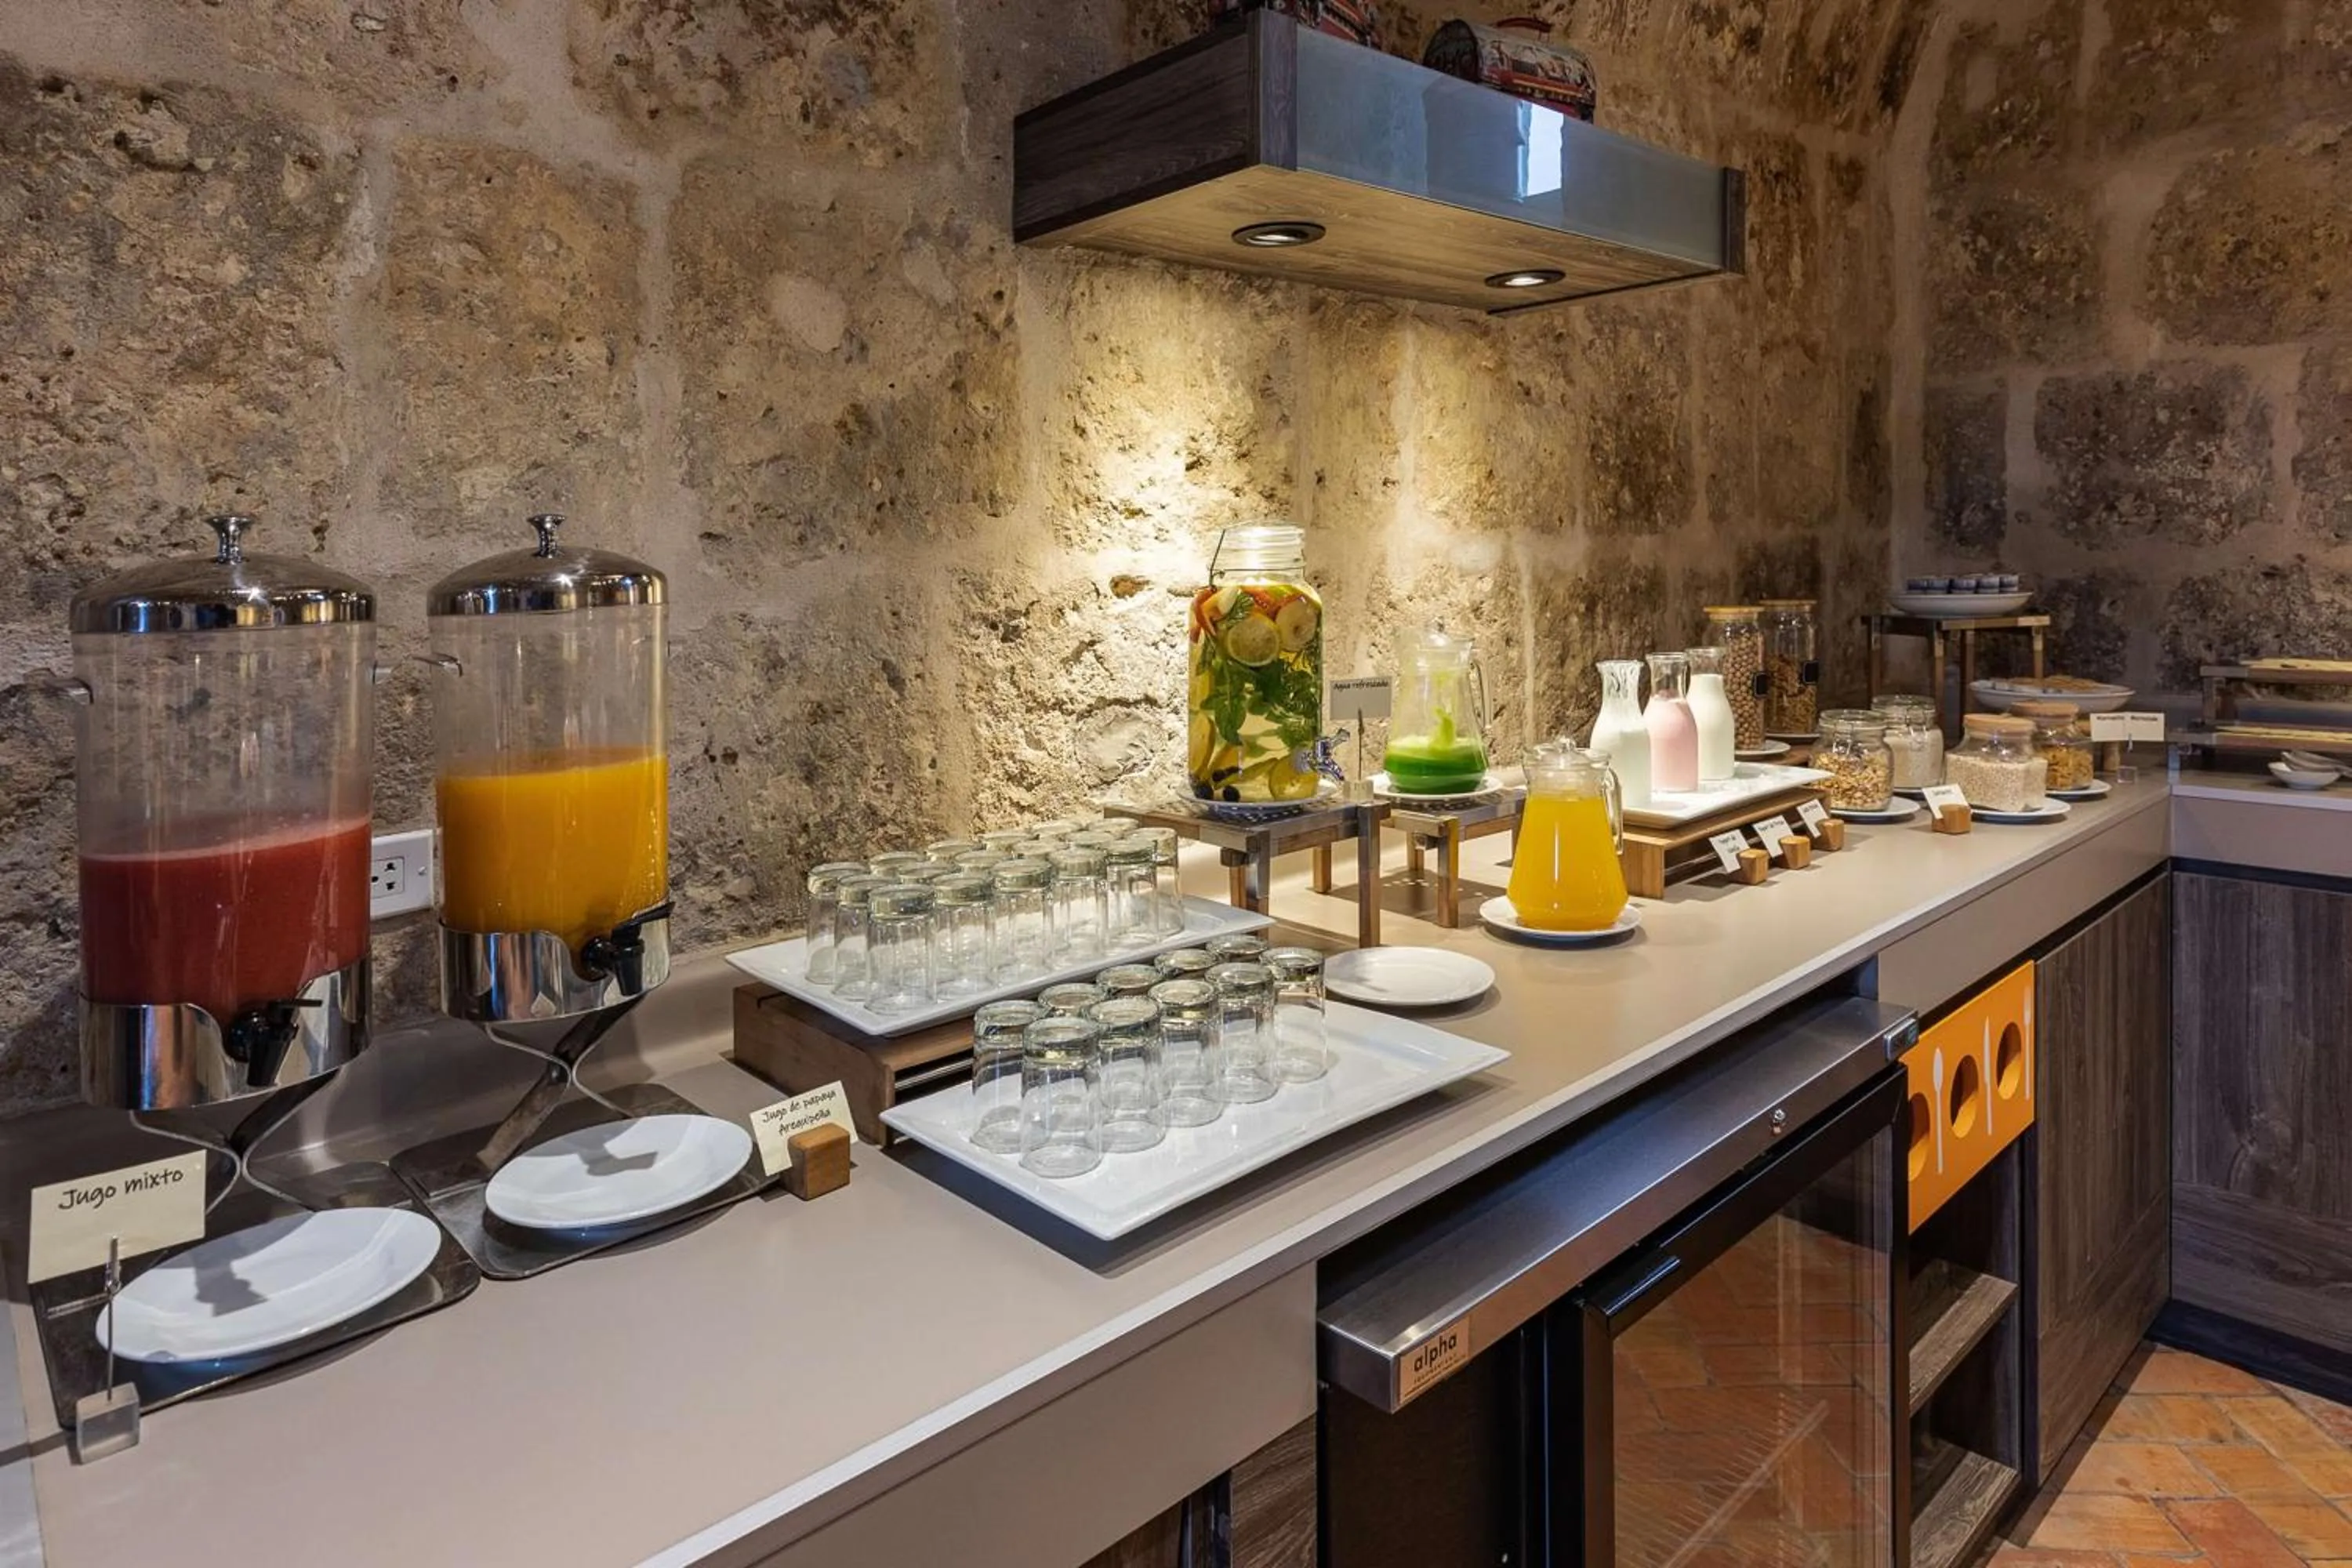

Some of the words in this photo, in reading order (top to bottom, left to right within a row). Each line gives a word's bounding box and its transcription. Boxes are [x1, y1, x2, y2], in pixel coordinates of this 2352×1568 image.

[762, 1107, 787, 1123] Jugo
[790, 1100, 801, 1112] de
[803, 1091, 837, 1109] papaya
[58, 1185, 117, 1210] Jugo
[125, 1168, 184, 1194] mixto
[1414, 1334, 1457, 1372] alpha
